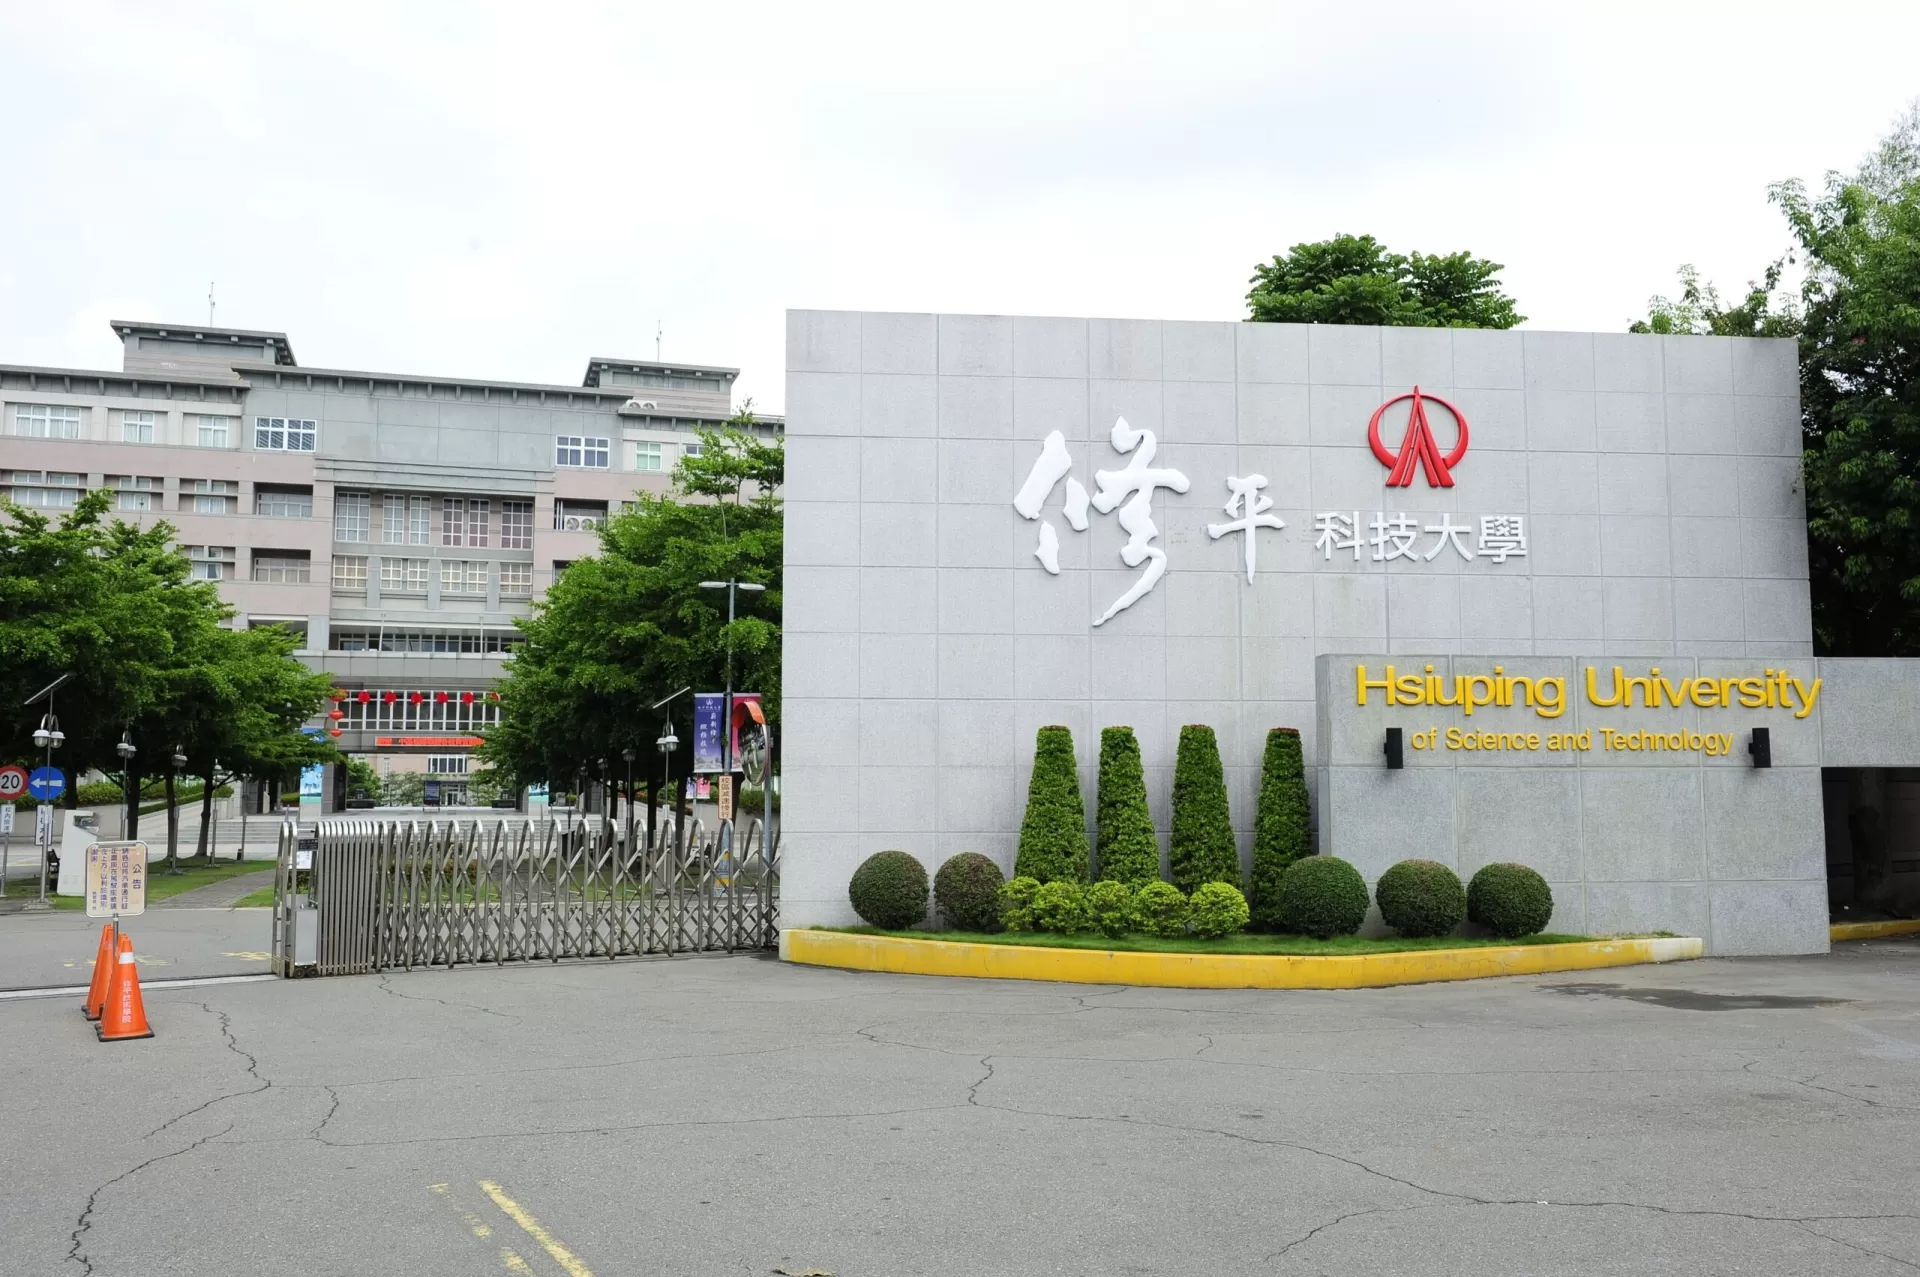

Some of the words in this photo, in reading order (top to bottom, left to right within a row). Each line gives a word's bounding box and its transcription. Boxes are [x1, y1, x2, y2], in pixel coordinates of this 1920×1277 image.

[1013, 415, 1287, 627] 修平
[1315, 511, 1529, 563] 科技大學
[1356, 664, 1566, 718] Hsiuping
[1586, 666, 1822, 718] University
[1411, 727, 1437, 750] of
[1445, 727, 1540, 751] Science
[1547, 728, 1591, 751] and
[1600, 727, 1734, 756] Technology
[1, 774, 20, 789] 20
[132, 863, 142, 890] 公告
